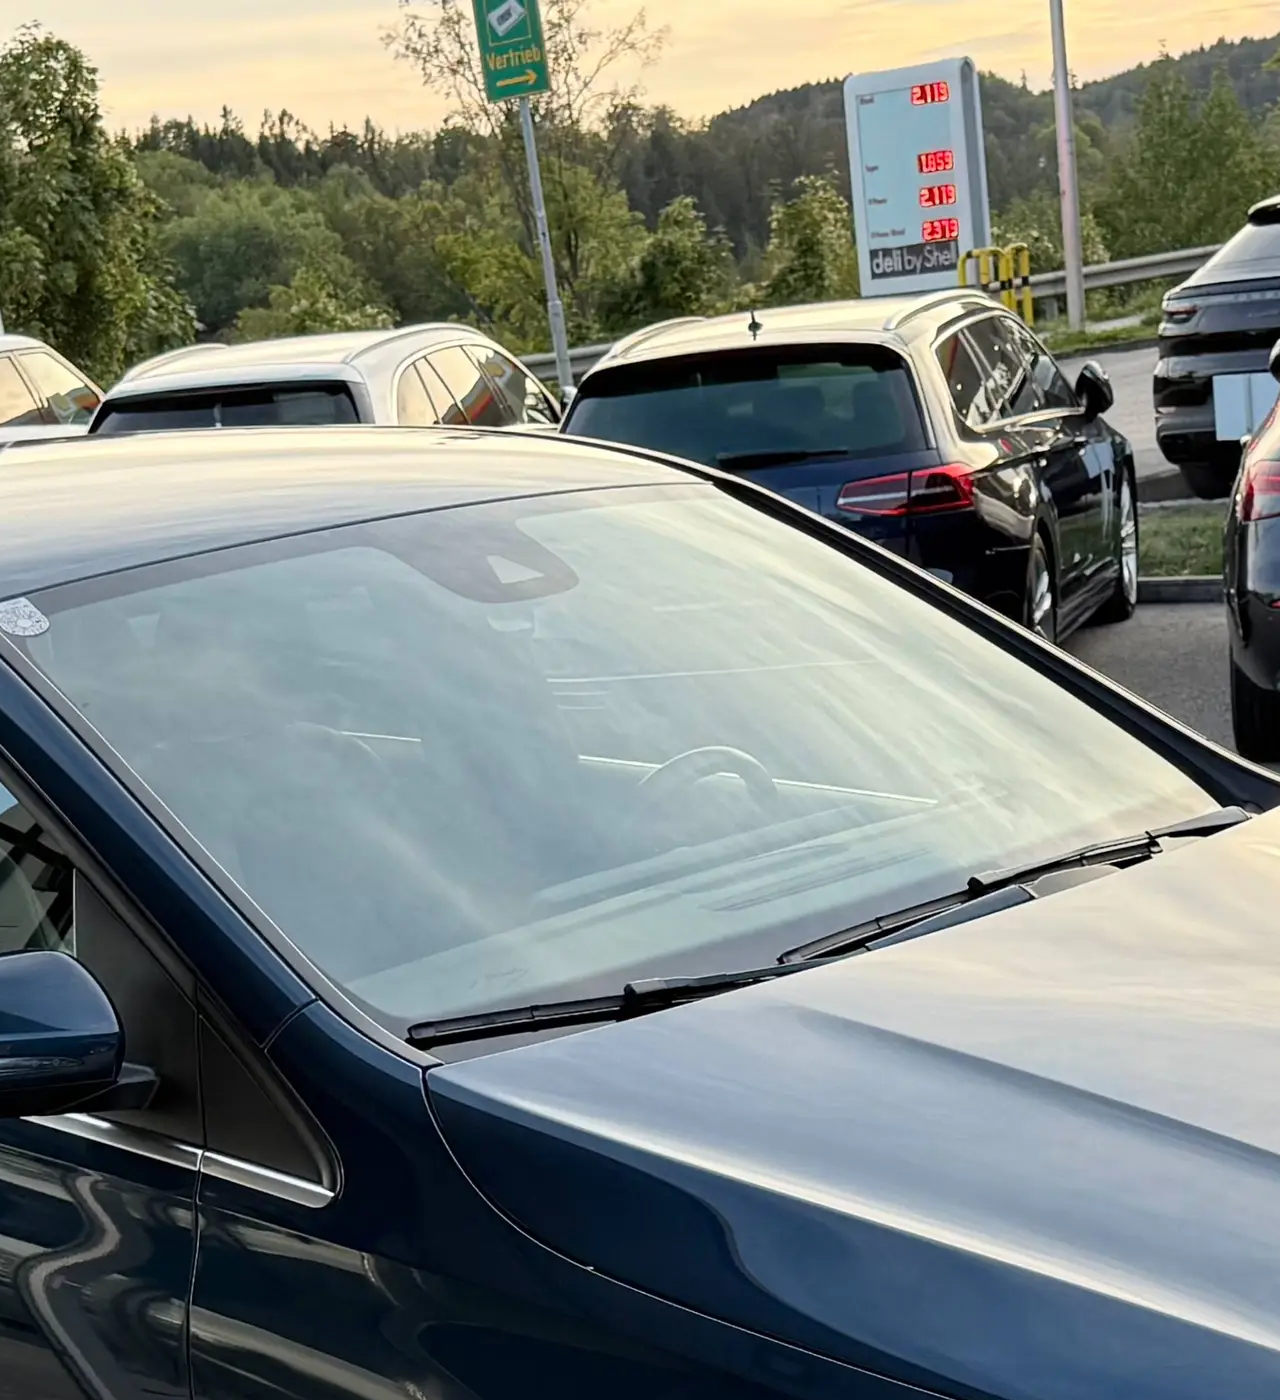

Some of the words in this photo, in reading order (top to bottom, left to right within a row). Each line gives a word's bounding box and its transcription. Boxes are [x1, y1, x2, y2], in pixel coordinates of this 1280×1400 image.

[486, 45, 541, 71] Vertrieb
[872, 250, 902, 274] deli
[904, 250, 923, 274] by
[923, 239, 957, 268] Shell
